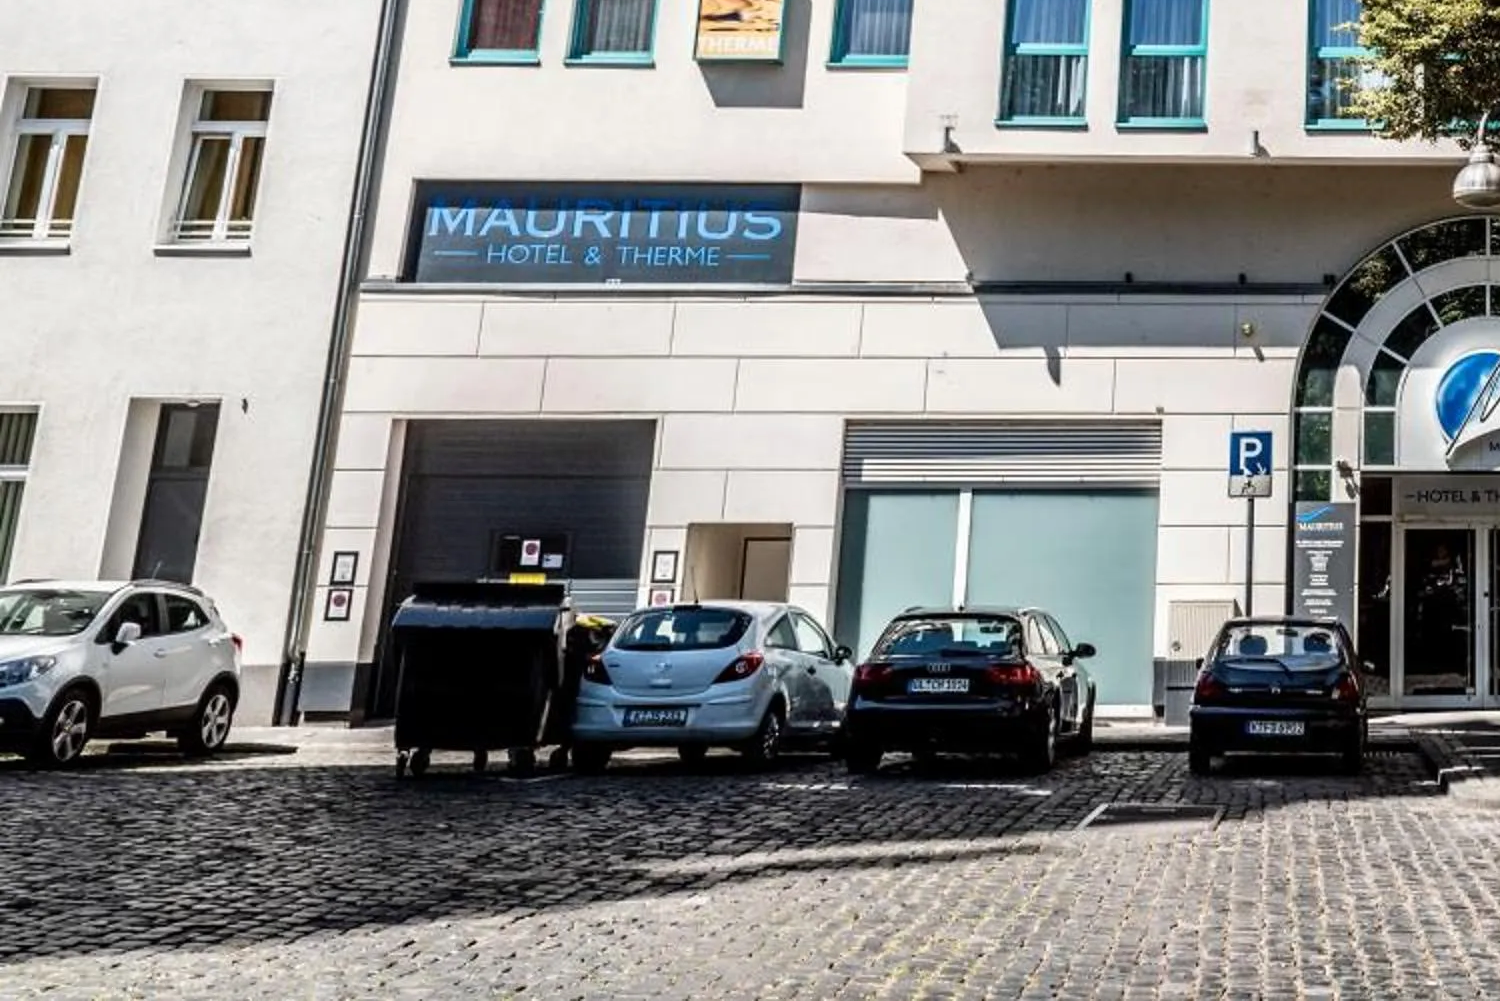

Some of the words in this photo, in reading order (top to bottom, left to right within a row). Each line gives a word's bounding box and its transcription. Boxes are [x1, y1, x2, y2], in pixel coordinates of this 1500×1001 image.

[427, 193, 783, 240] MAURITIUS
[486, 243, 572, 266] HOTEL
[583, 248, 601, 265] &
[616, 245, 721, 267] THERME
[1239, 437, 1263, 475] P
[1416, 489, 1468, 504] HOTEL
